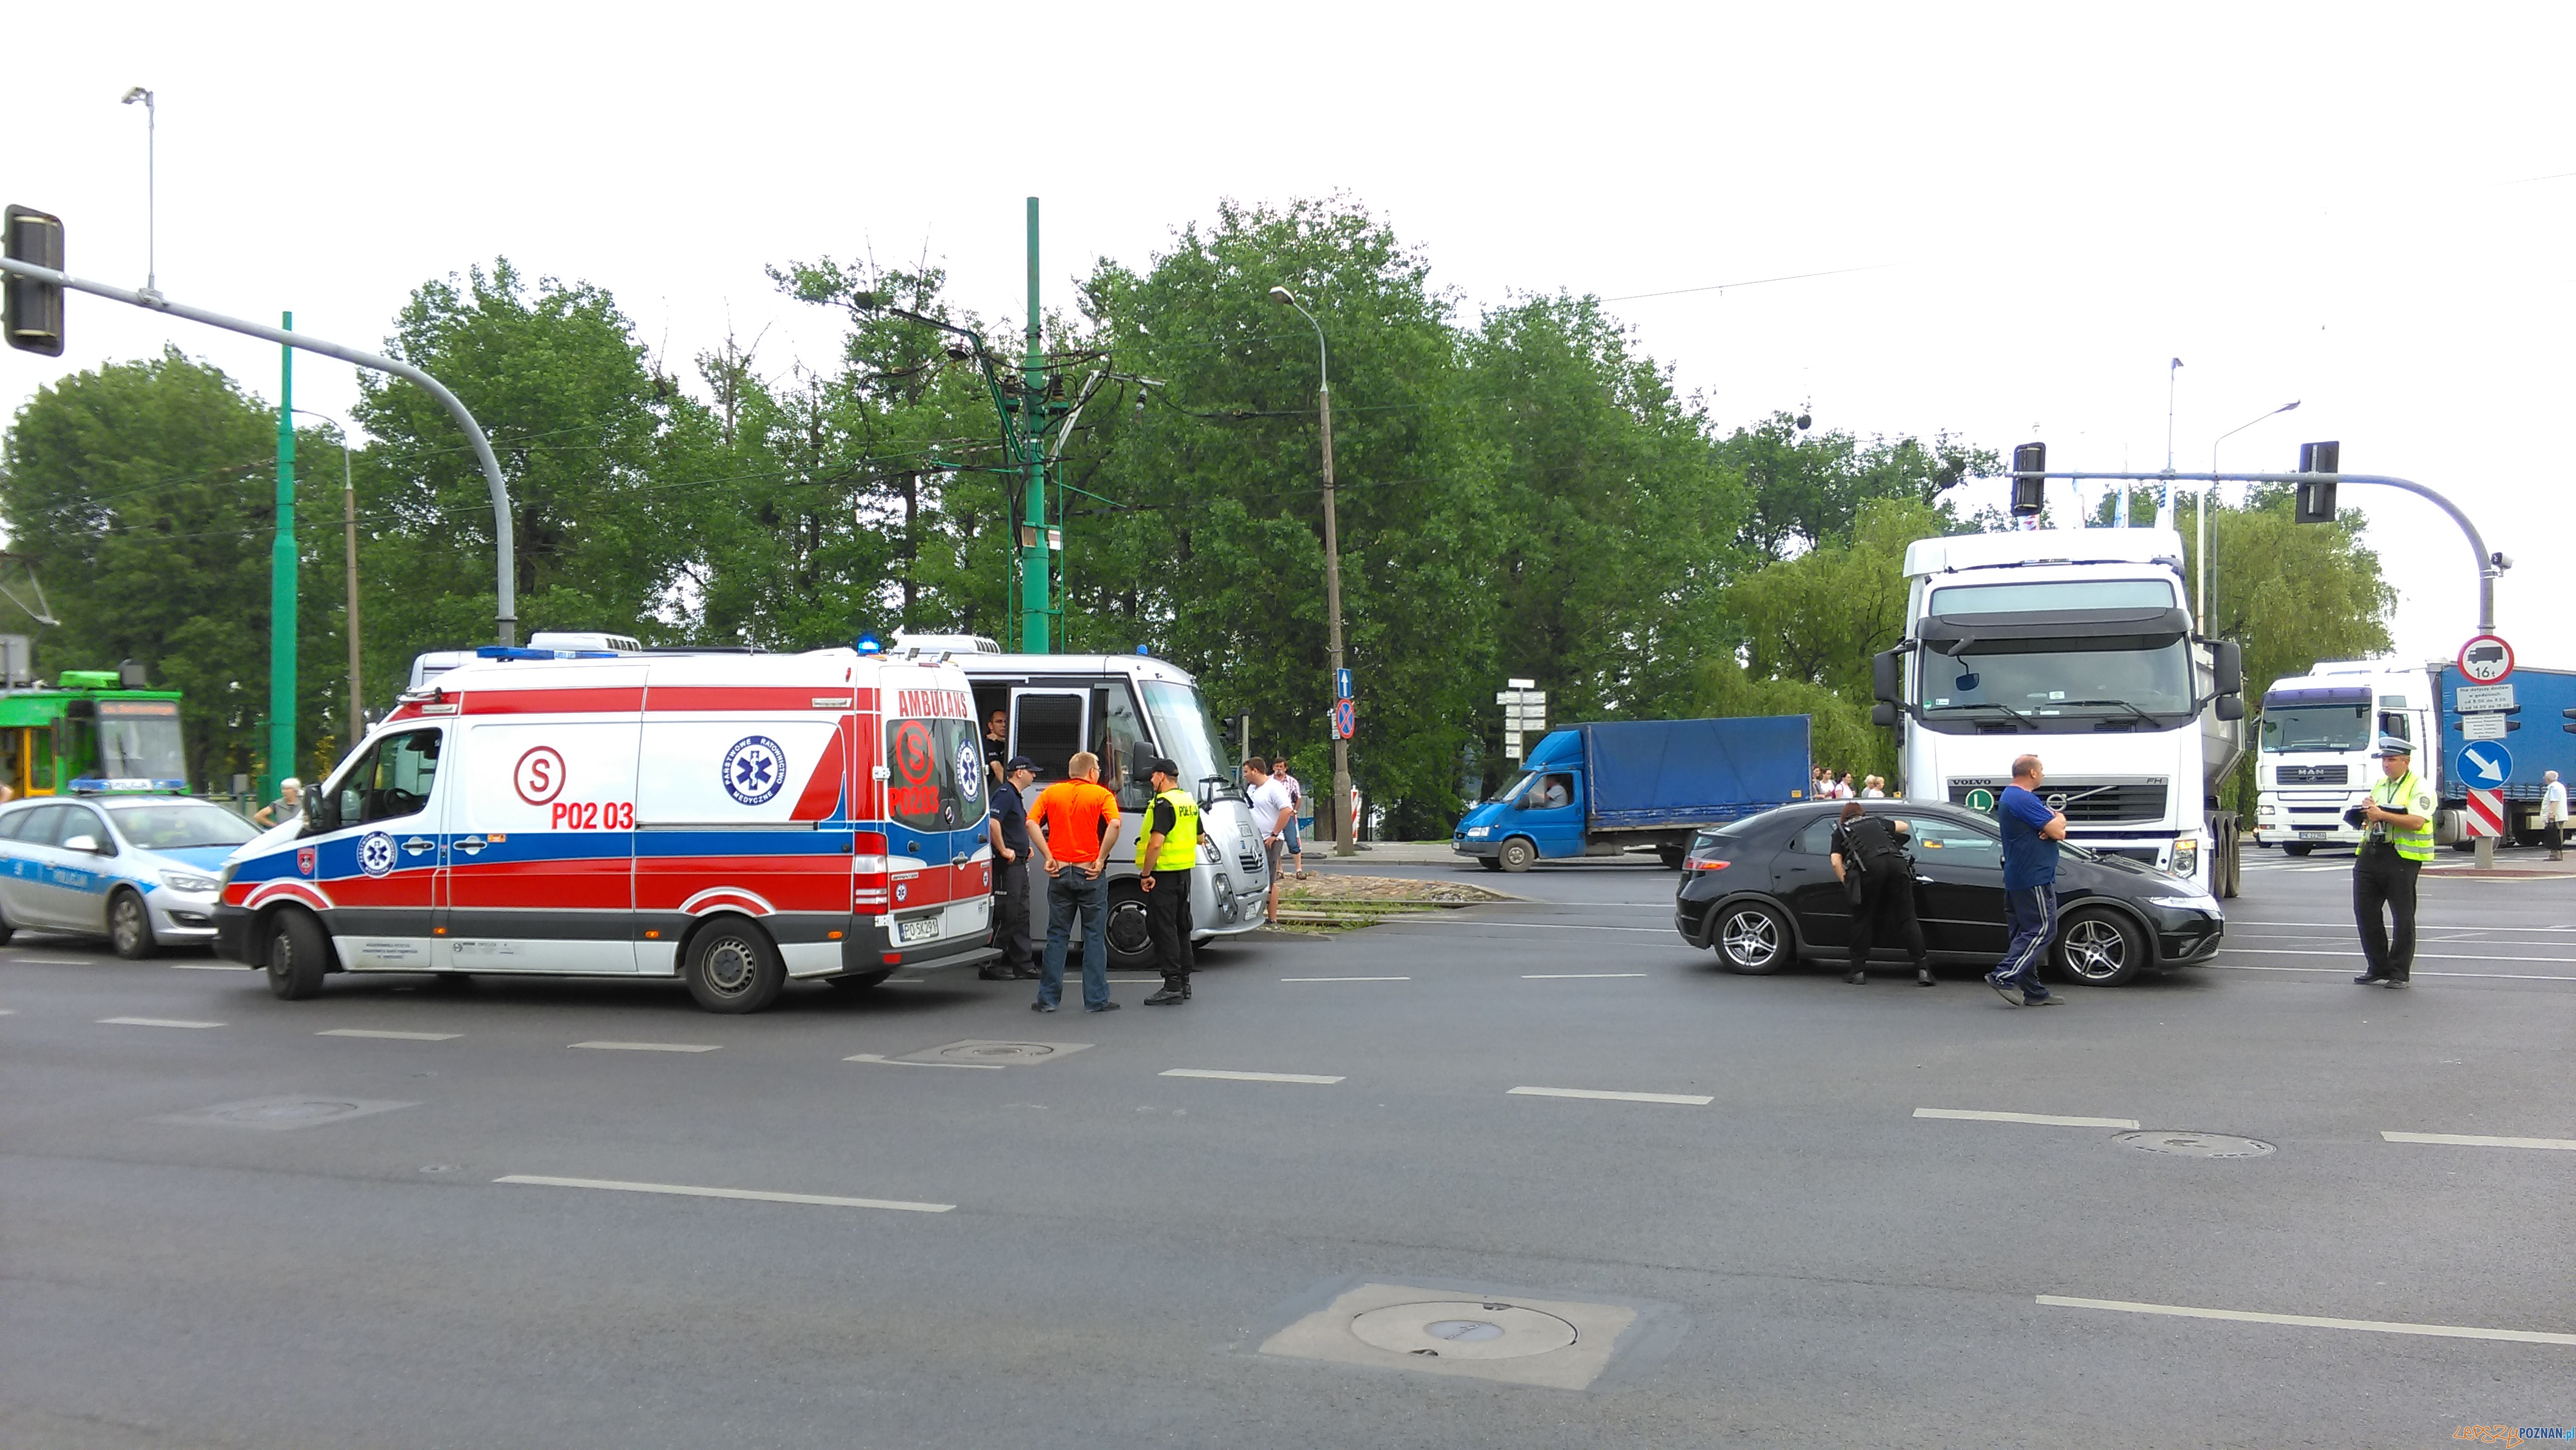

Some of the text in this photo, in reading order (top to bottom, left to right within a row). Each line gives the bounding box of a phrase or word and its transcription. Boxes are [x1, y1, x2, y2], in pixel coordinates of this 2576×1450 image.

[899, 691, 967, 718] AMBULANS
[907, 734, 925, 770] S
[530, 759, 550, 792] S
[723, 738, 785, 803] PAŃSTWOWE RATOWNICTWO MEDYCZNE
[1974, 794, 1986, 810] L
[904, 924, 915, 937] PO
